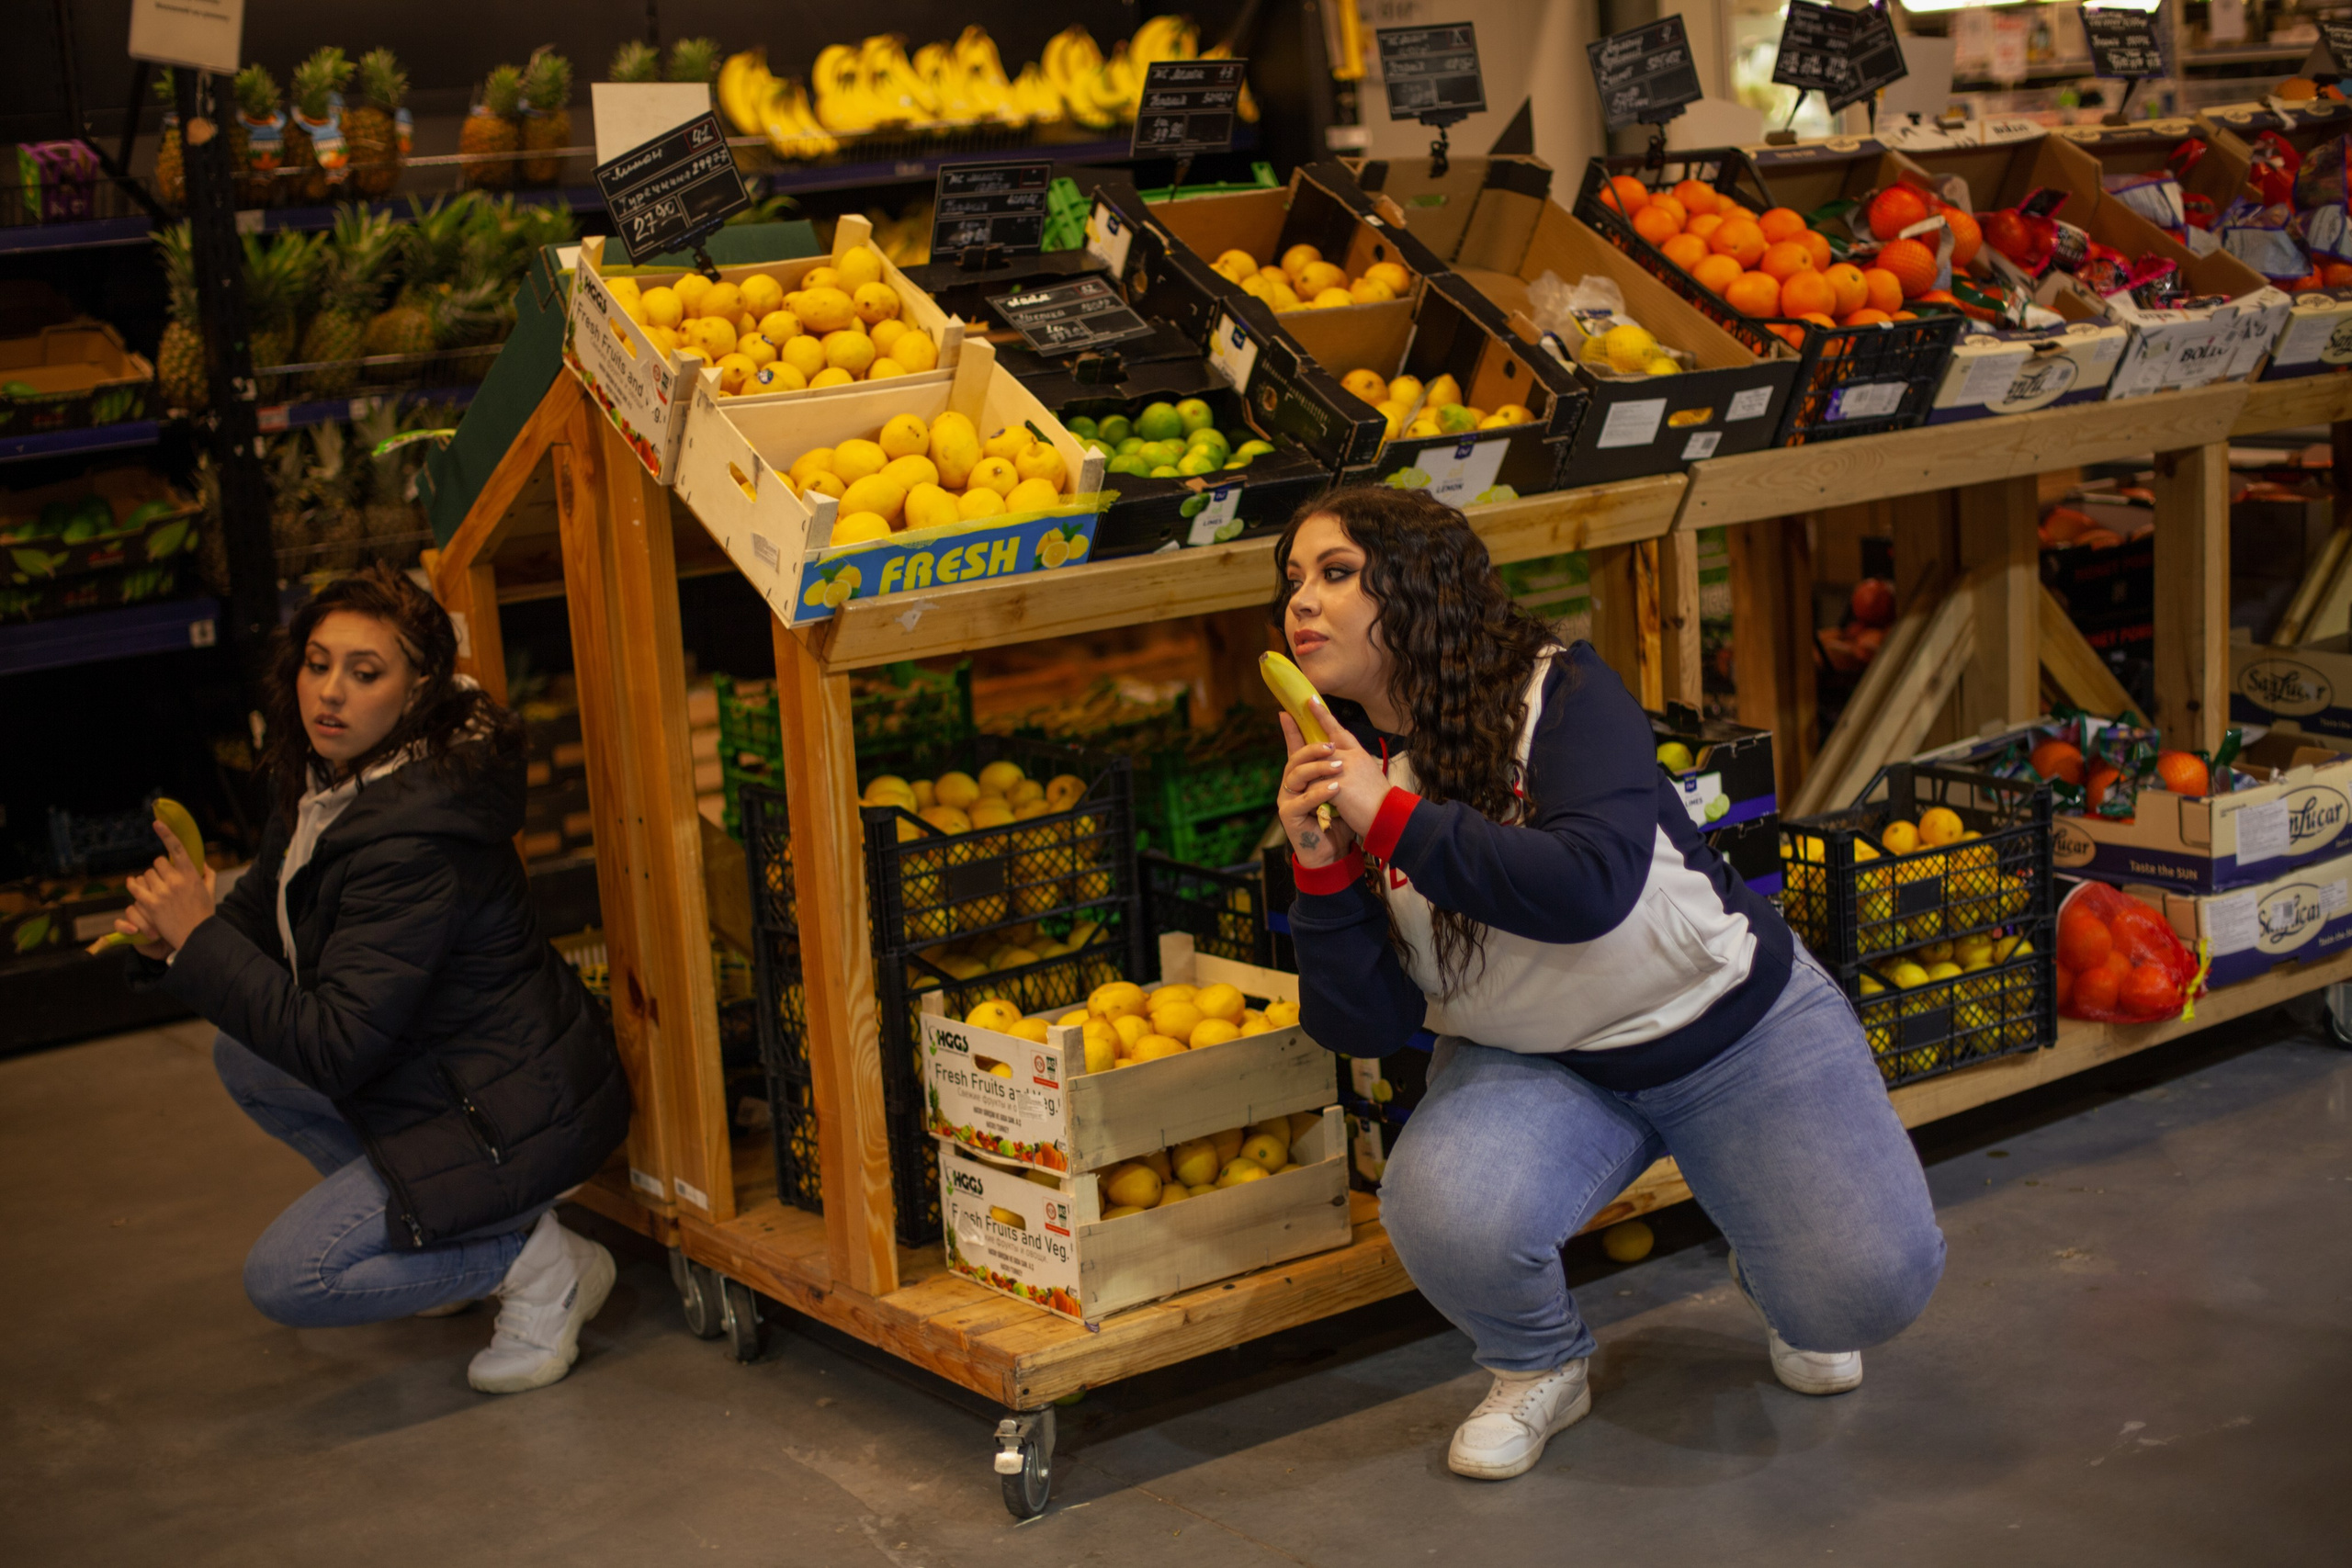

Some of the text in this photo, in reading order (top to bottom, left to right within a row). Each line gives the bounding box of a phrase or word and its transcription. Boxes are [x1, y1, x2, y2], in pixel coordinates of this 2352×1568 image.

[584, 276, 607, 315] HGGS
[576, 301, 601, 339] Fresh
[602, 333, 627, 375] Fruits
[627, 371, 644, 397] and
[1203, 517, 1223, 527] LIMES
[878, 536, 1021, 596] FRESH
[2247, 669, 2326, 703] SanLucr
[1685, 797, 1703, 807] LIMES
[2288, 796, 2344, 844] nLucar
[2130, 860, 2199, 881] Taste the SUN
[936, 1029, 969, 1054] HGGS
[934, 1063, 968, 1088] Fresh
[971, 1072, 1005, 1098] Fruits
[953, 1170, 984, 1195] HGGS
[952, 1202, 1070, 1263] Fsh Fruits and Veg.
